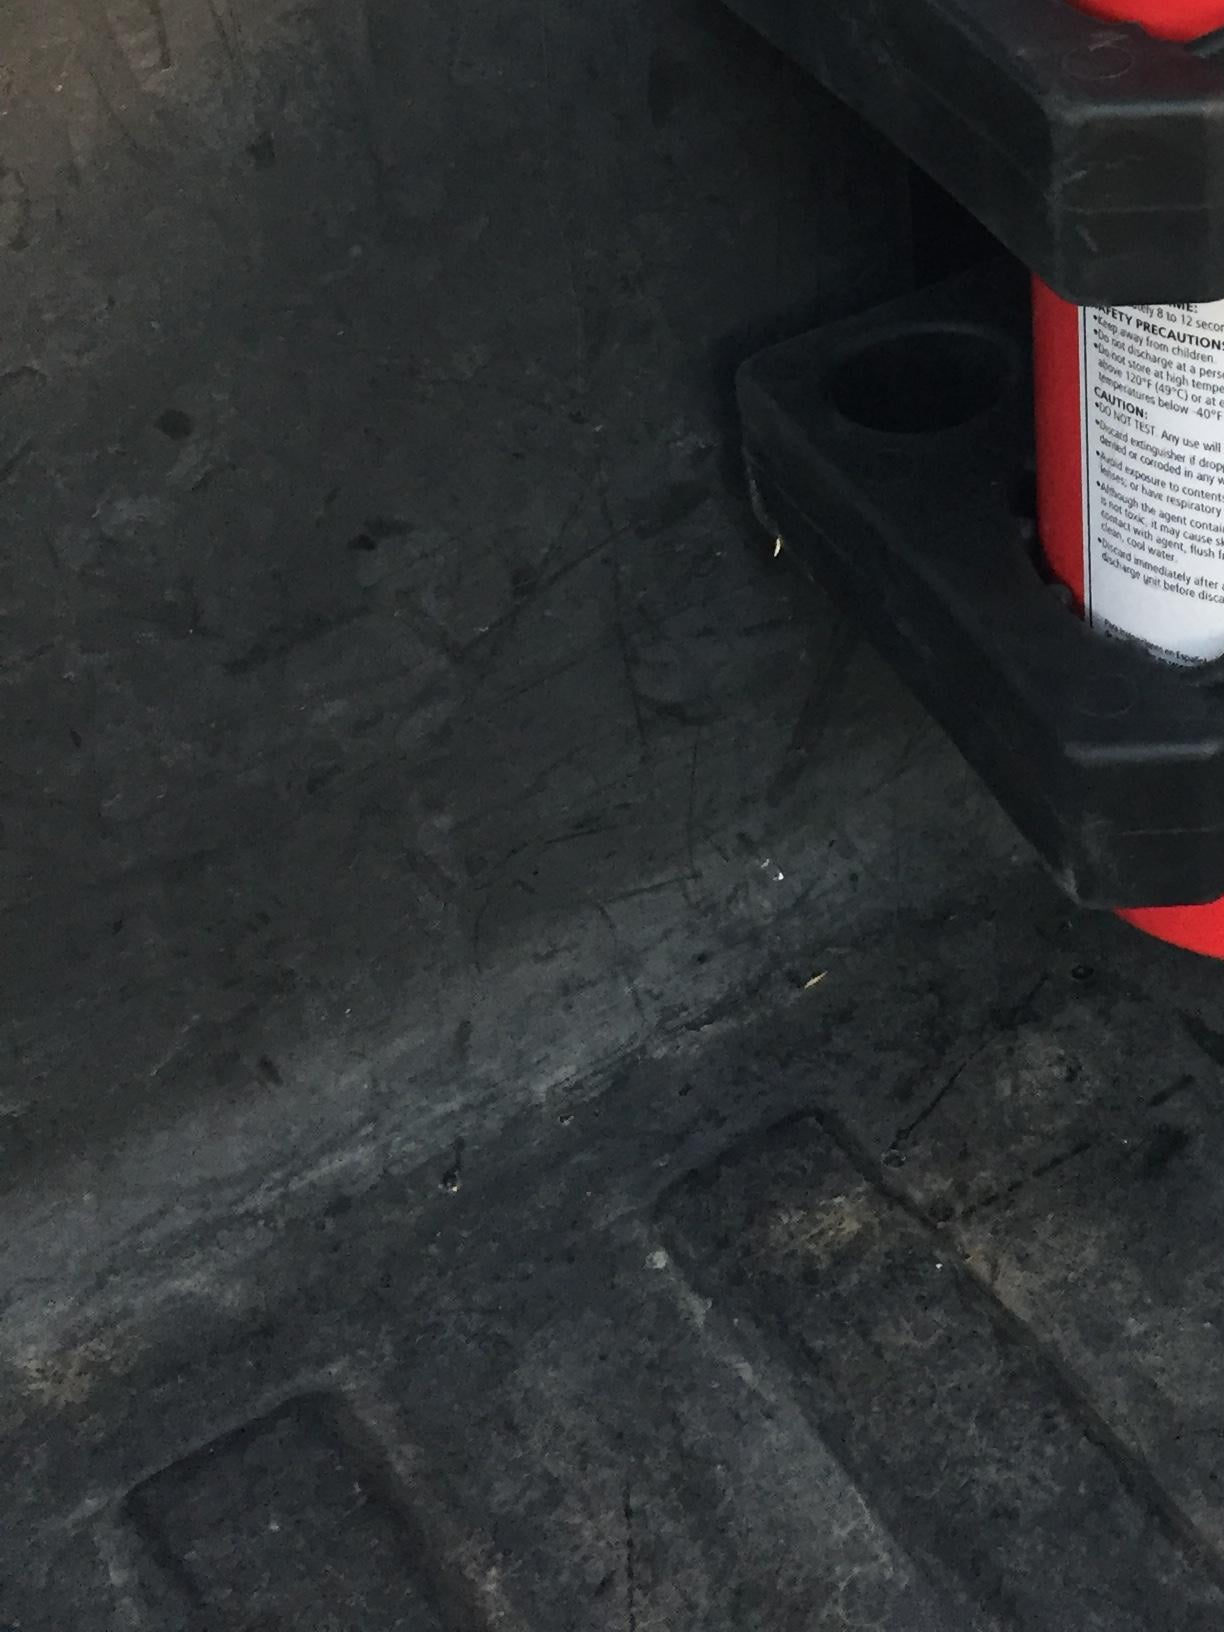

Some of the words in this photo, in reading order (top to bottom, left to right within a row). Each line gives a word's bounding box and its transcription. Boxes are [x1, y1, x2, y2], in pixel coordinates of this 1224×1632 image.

[1166, 311, 1177, 323] to
[1181, 314, 1192, 327] 12
[1120, 328, 1143, 347] away
[1146, 335, 1169, 353] from
[1128, 346, 1174, 371] discharge
[1176, 361, 1187, 373] at
[1189, 364, 1196, 374] a
[1128, 359, 1151, 375] store
[1153, 369, 1164, 380] at
[1166, 371, 1189, 388] high
[1094, 386, 1149, 420] CAUTION:
[1158, 396, 1189, 414] below
[1191, 393, 1202, 404] or
[1205, 396, 1216, 407] at
[1099, 402, 1111, 417] DO
[1113, 406, 1133, 427] NOT
[1160, 430, 1180, 446] Any
[1182, 437, 1200, 449] use
[1202, 441, 1221, 453] will
[1130, 436, 1186, 463] extinguisher
[1189, 455, 1197, 466] if
[1125, 464, 1167, 489] exposure
[1169, 481, 1180, 493] to
[1128, 449, 1138, 460] or
[1184, 466, 1193, 479] in
[1196, 472, 1215, 486] any
[1129, 481, 1139, 492] or
[1141, 484, 1164, 501] have
[1166, 494, 1222, 518] respiratory
[1141, 502, 1156, 515] the
[1158, 508, 1187, 525] agent
[1126, 536, 1146, 552] cool
[1133, 527, 1153, 542] with
[1190, 543, 1215, 559] flush
[1151, 520, 1158, 530] it
[1160, 524, 1181, 538] may
[1182, 530, 1213, 545] cause
[1134, 555, 1192, 585] immediately
[1193, 575, 1218, 590] after
[1163, 579, 1196, 598] before
